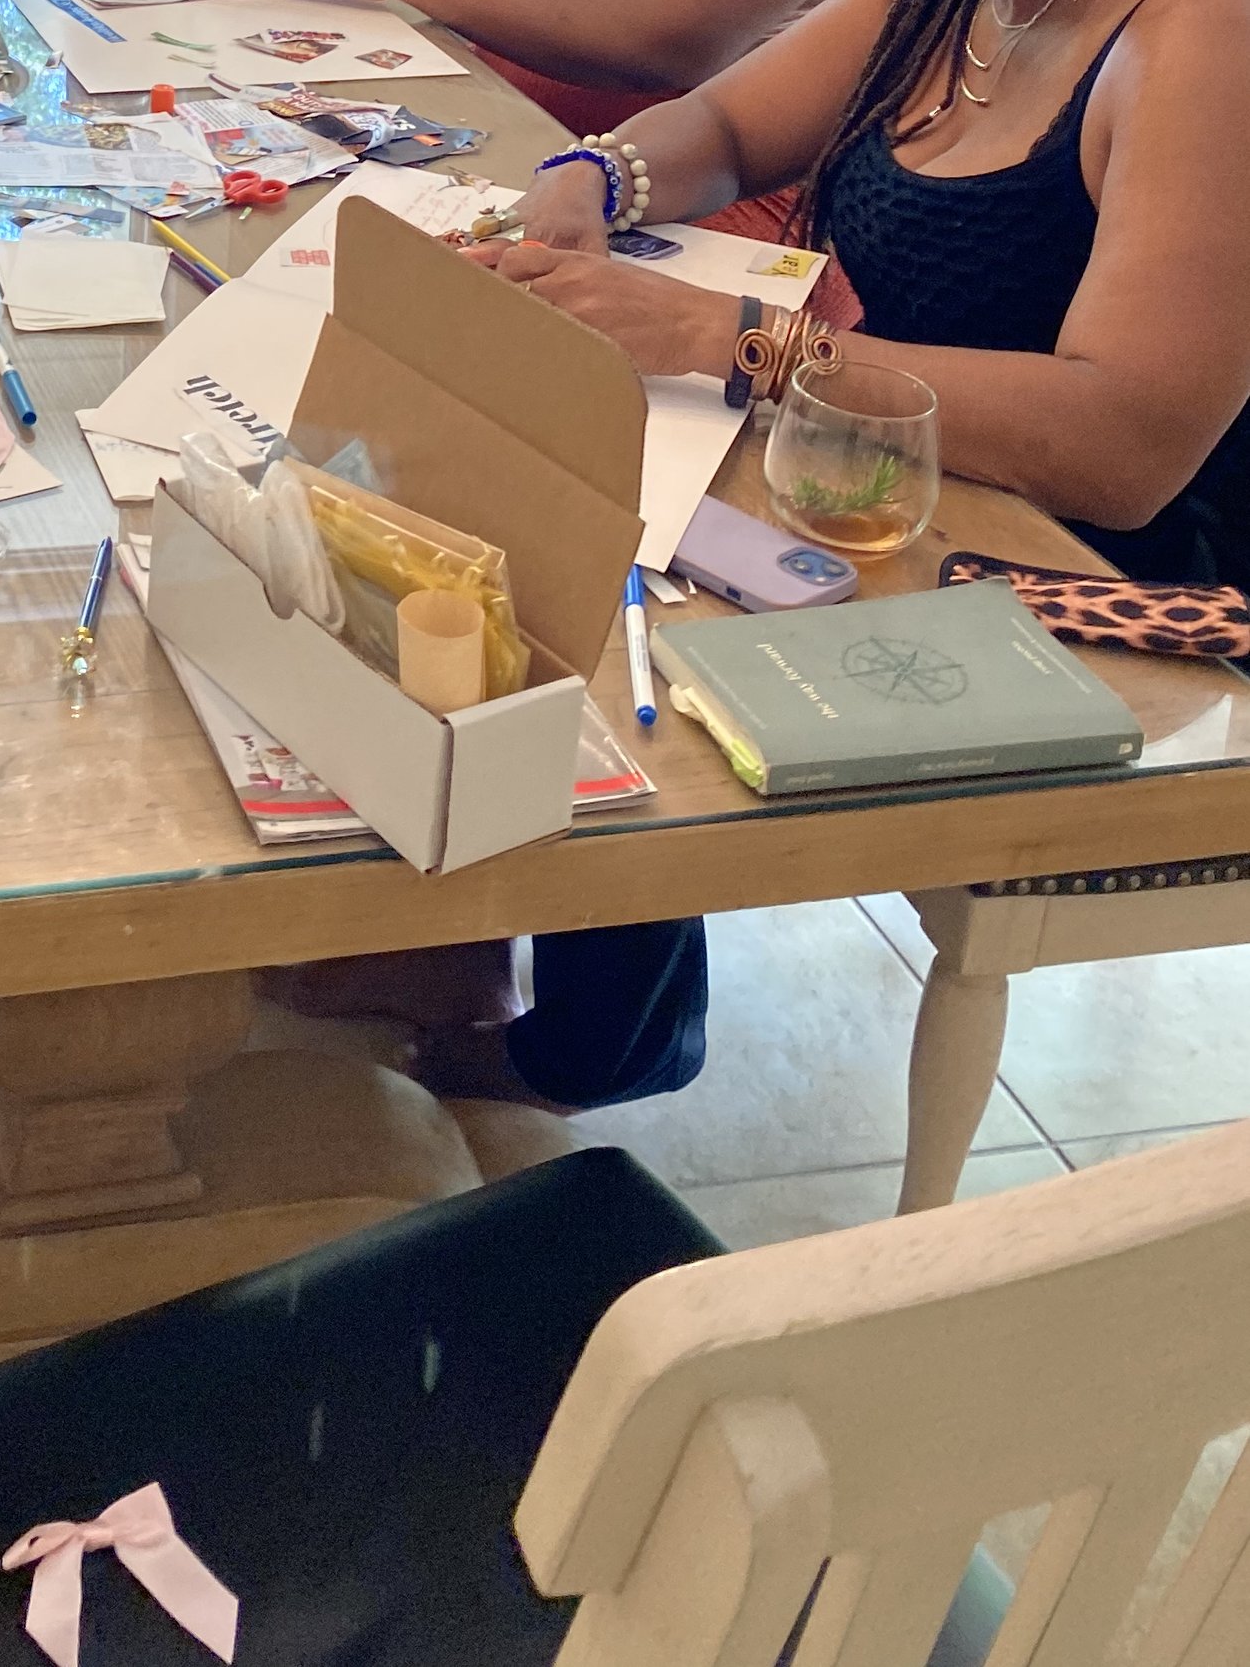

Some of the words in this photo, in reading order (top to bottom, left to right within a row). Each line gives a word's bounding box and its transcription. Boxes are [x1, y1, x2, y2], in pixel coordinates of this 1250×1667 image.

[779, 254, 803, 278] Year
[182, 374, 286, 455] tretch
[755, 643, 803, 681] forward
[798, 682, 821, 702] way
[817, 702, 839, 719] the
